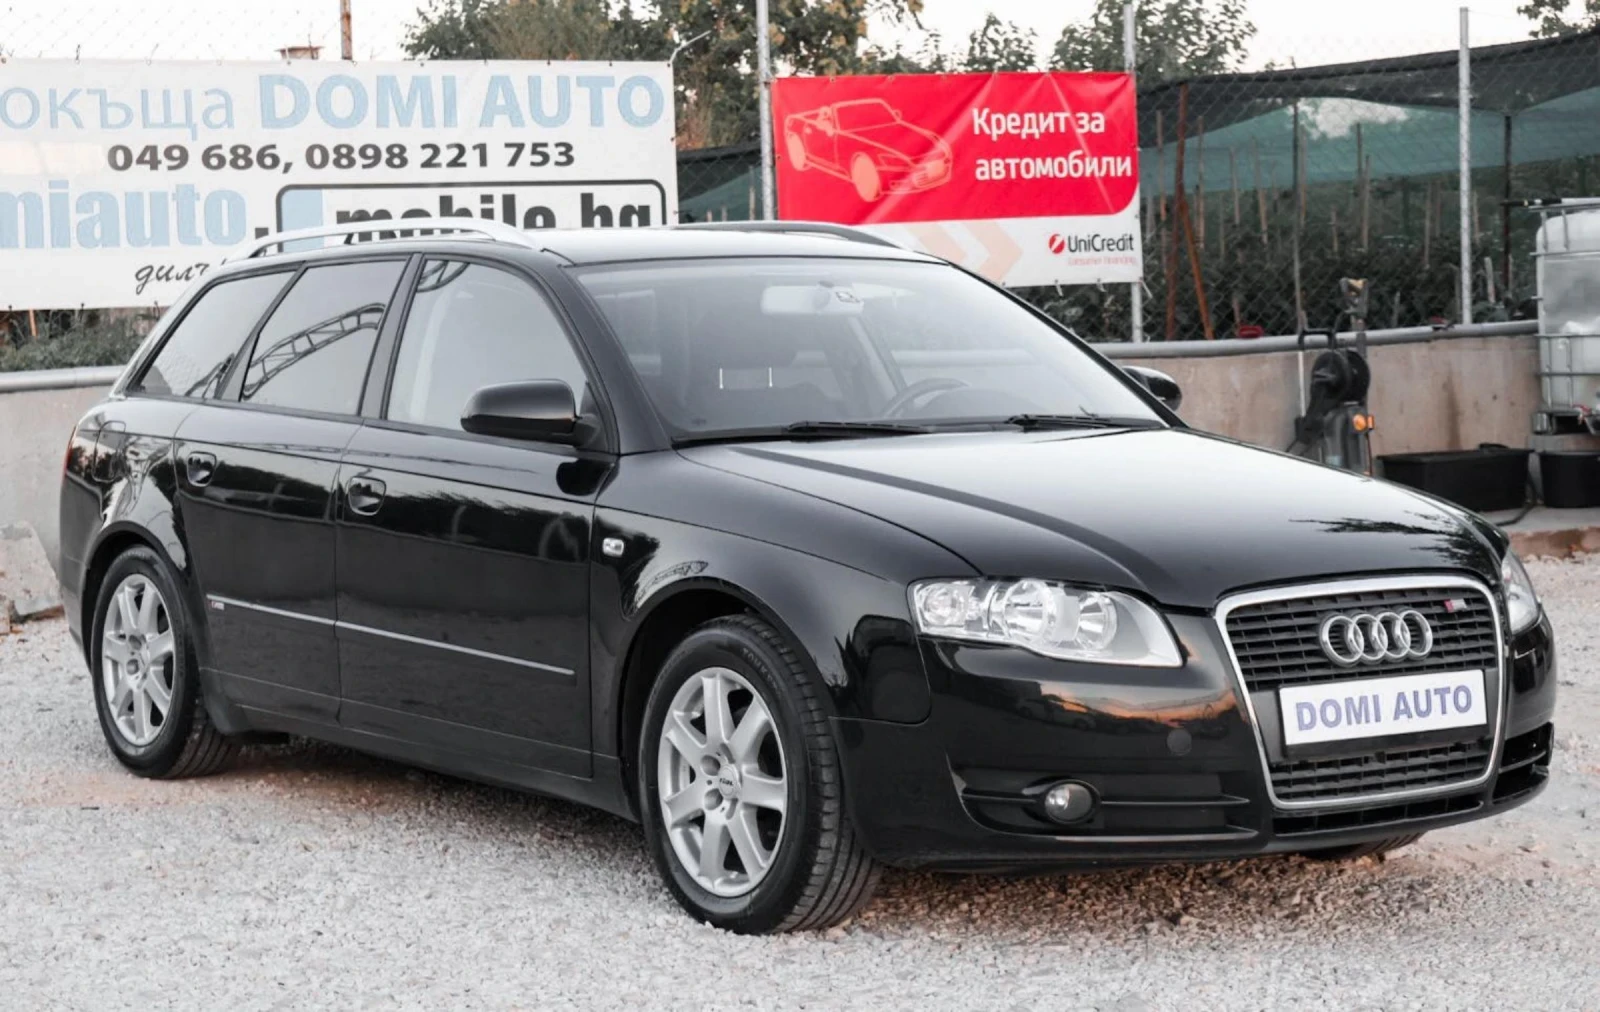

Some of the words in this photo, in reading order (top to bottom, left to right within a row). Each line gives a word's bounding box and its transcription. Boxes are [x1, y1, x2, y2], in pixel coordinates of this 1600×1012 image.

[0, 87, 235, 141] окъща
[259, 74, 458, 129] DOMI
[479, 74, 664, 128] AUTO
[972, 108, 1070, 141] Кредит
[1075, 112, 1105, 134] за
[107, 144, 189, 171] 049
[201, 143, 293, 174] 686,
[305, 143, 409, 169] 0898
[420, 143, 488, 168] 221
[504, 142, 575, 167] 753
[975, 150, 1132, 180] автомобили
[1068, 233, 1134, 253] UniCredit
[1296, 694, 1381, 731] DOMI
[1393, 685, 1472, 721] AUTO
